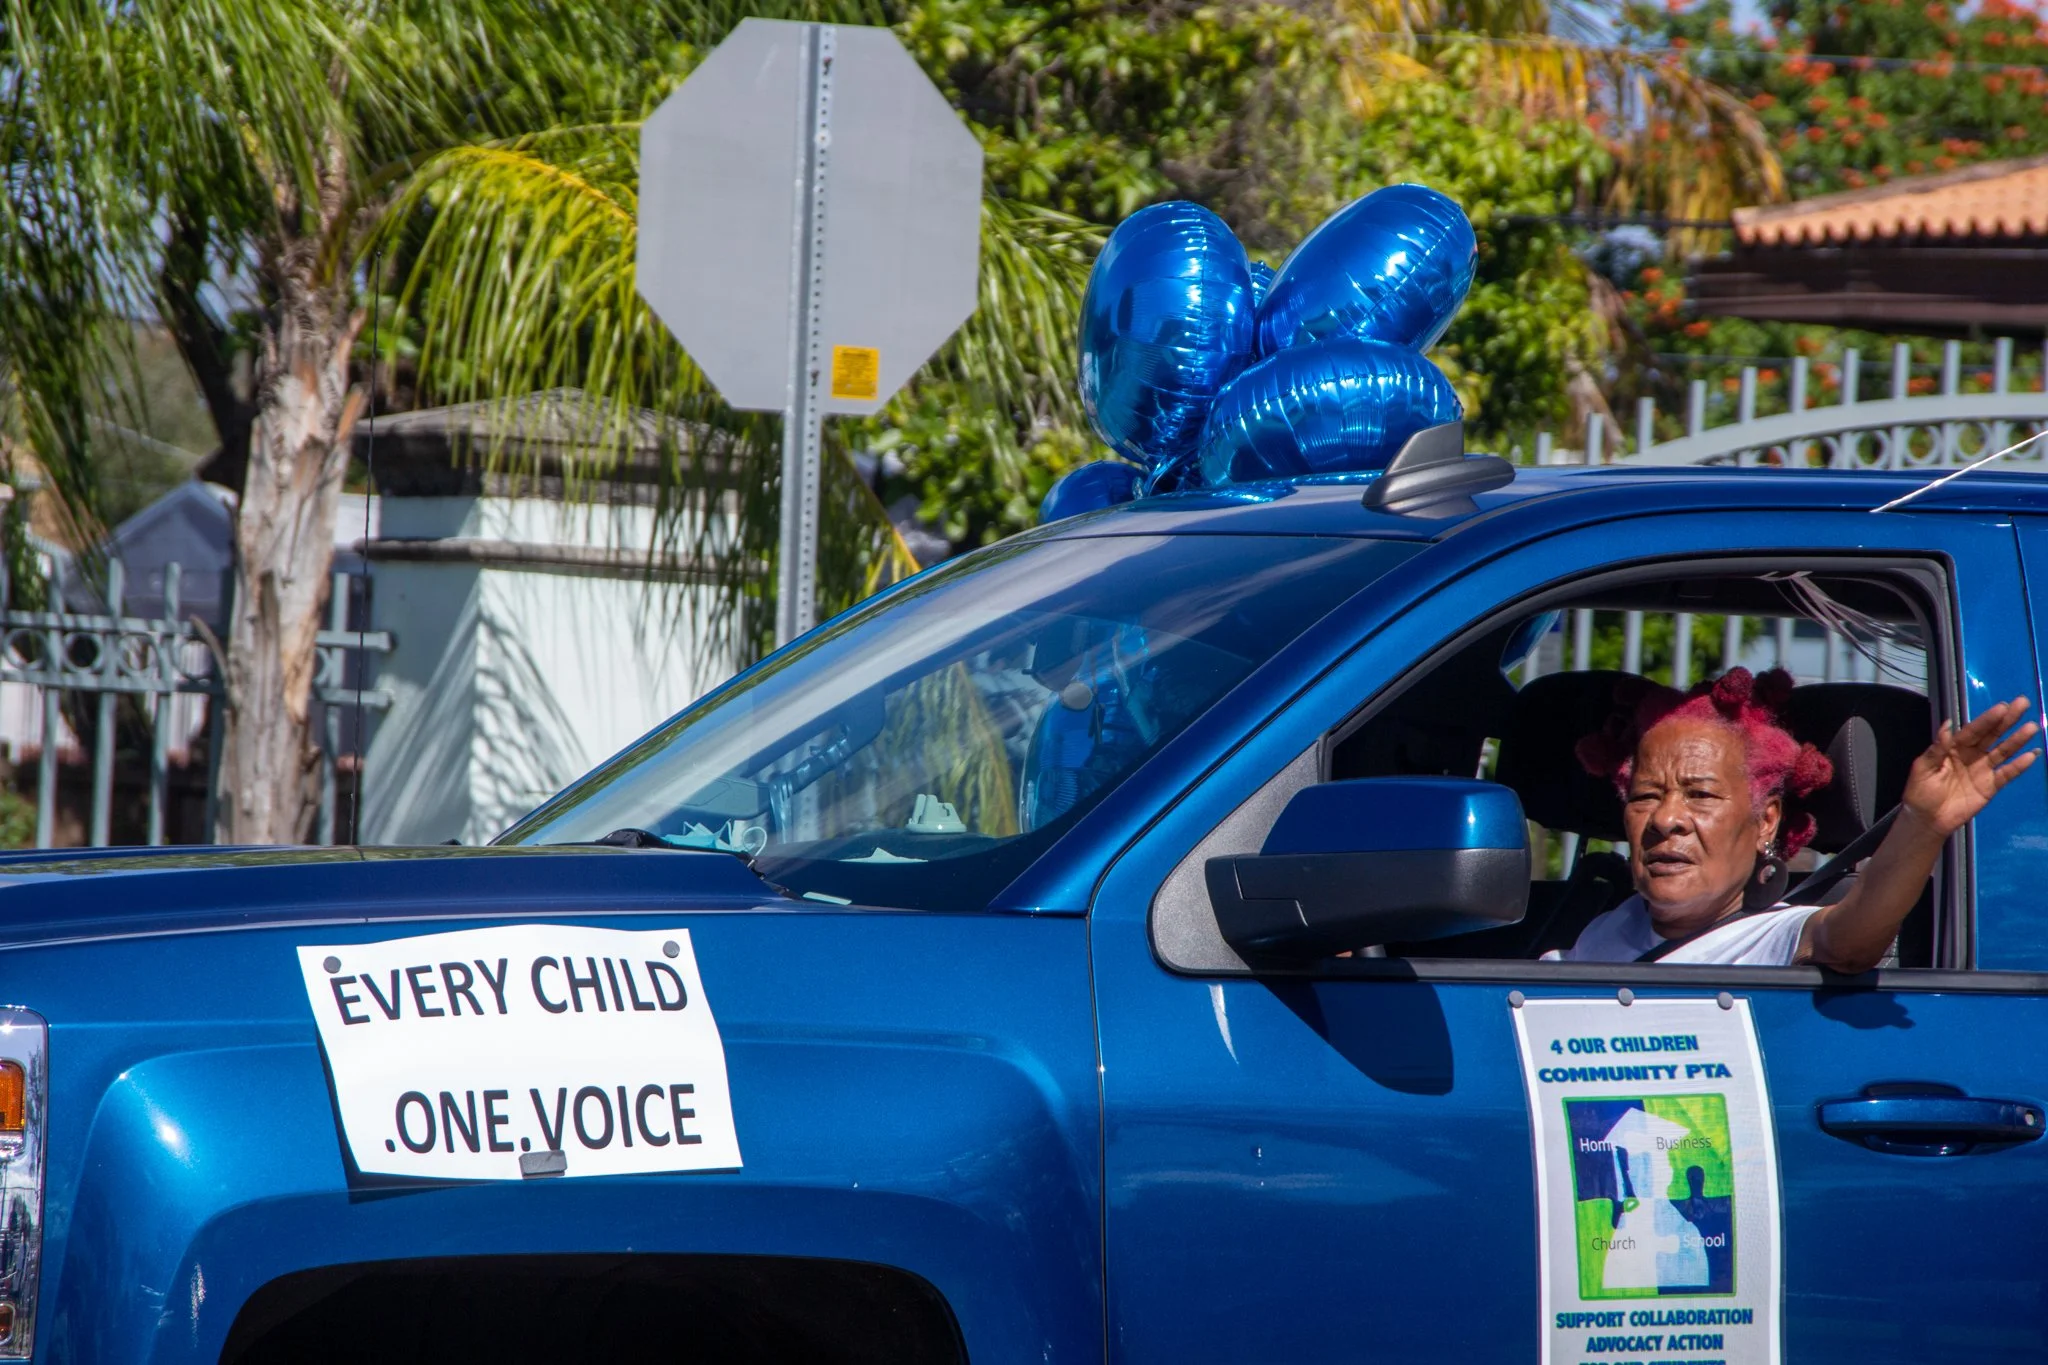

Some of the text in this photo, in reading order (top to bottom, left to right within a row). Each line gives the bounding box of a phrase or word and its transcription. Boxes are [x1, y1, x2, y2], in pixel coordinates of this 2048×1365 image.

[329, 955, 688, 1026] EVERY CHILD
[1550, 1034, 1699, 1055] 4 OUR CHILDREN
[1538, 1063, 1733, 1083] COMMUNITY PTA
[1580, 1137, 1616, 1152] Hom
[1656, 1136, 1712, 1150] Business
[1591, 1236, 1636, 1251] Church
[1683, 1232, 1725, 1248] Sool
[1555, 1308, 1754, 1330] SUPPORT COLLABORATION
[1585, 1333, 1724, 1353] ADVOCACY ACTION
